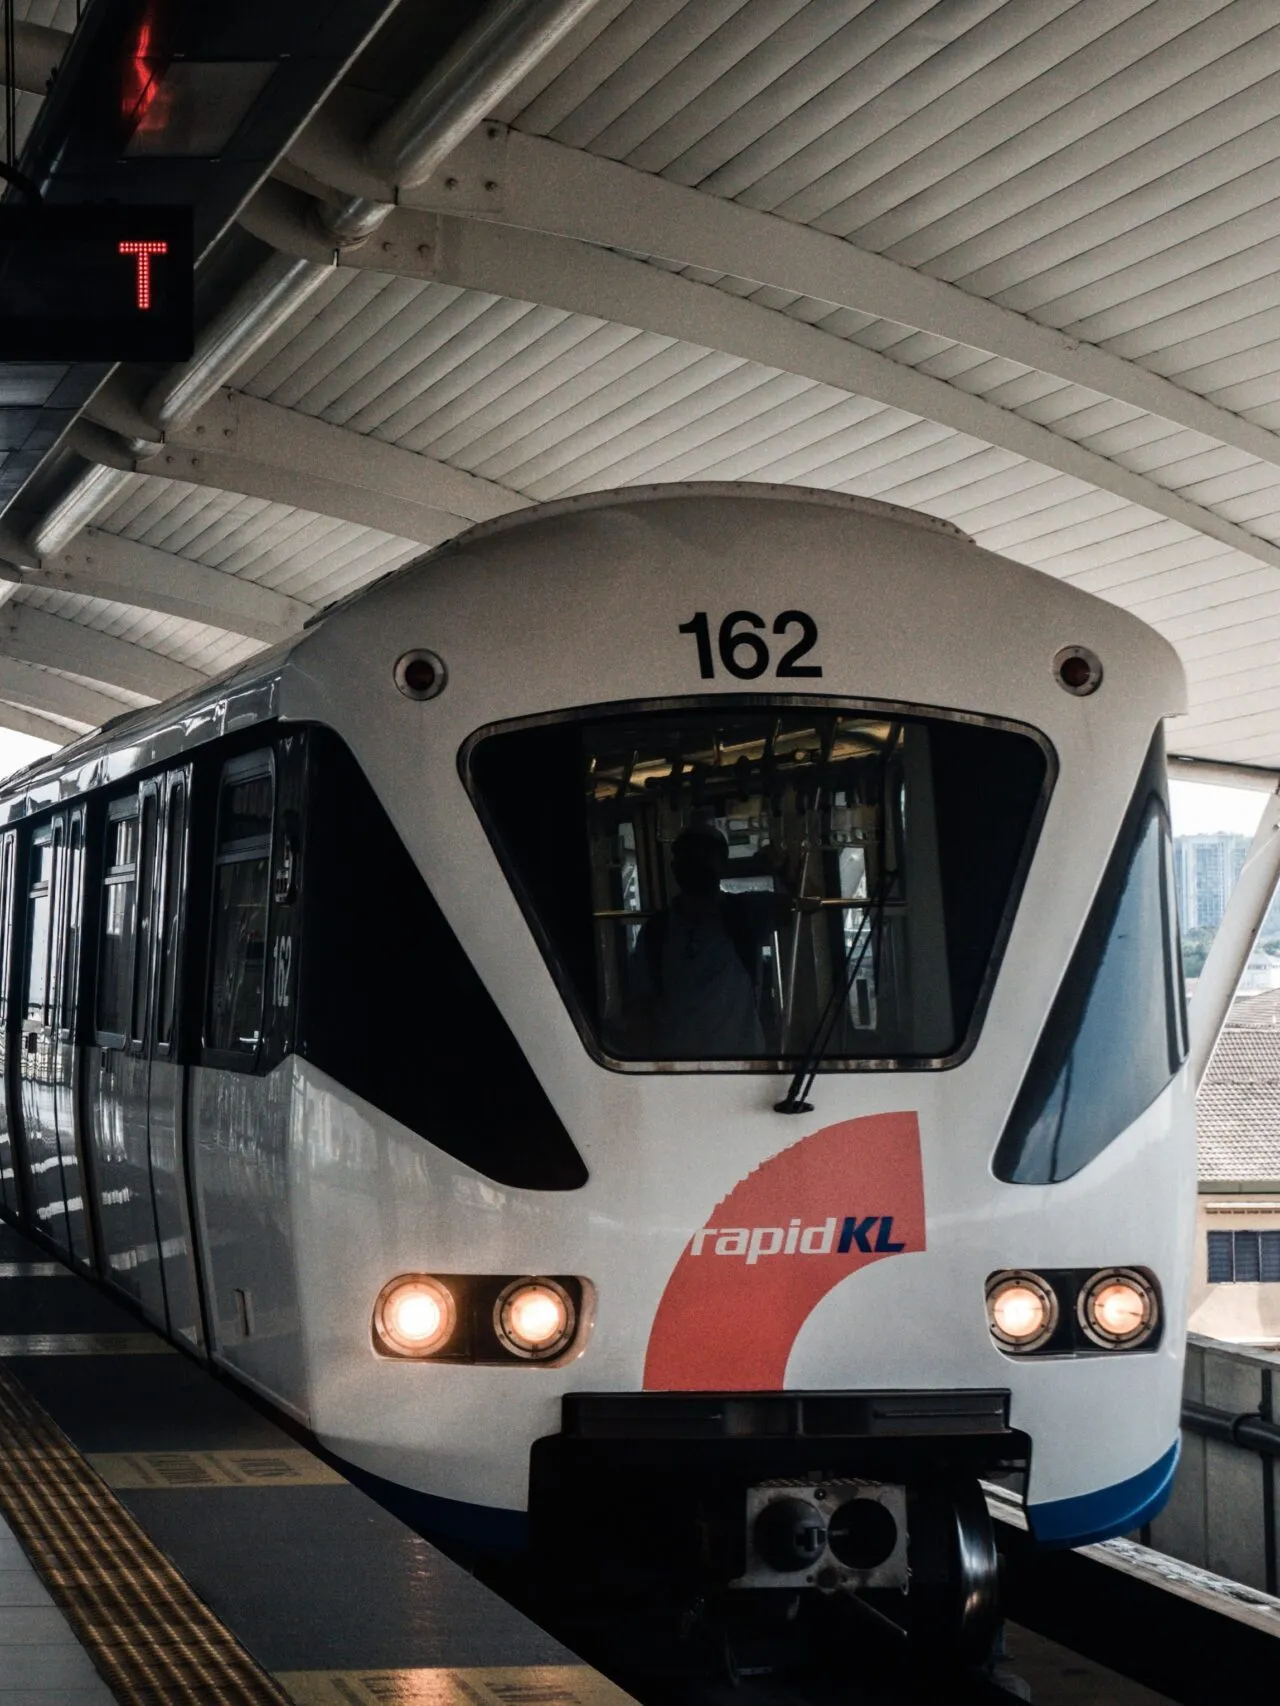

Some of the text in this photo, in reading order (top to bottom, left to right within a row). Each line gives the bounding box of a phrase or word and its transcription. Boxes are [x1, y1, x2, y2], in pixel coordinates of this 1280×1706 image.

[118, 240, 168, 310] T
[678, 609, 824, 681] 162
[272, 935, 292, 1007] 162
[690, 1216, 905, 1265] rapidKL
